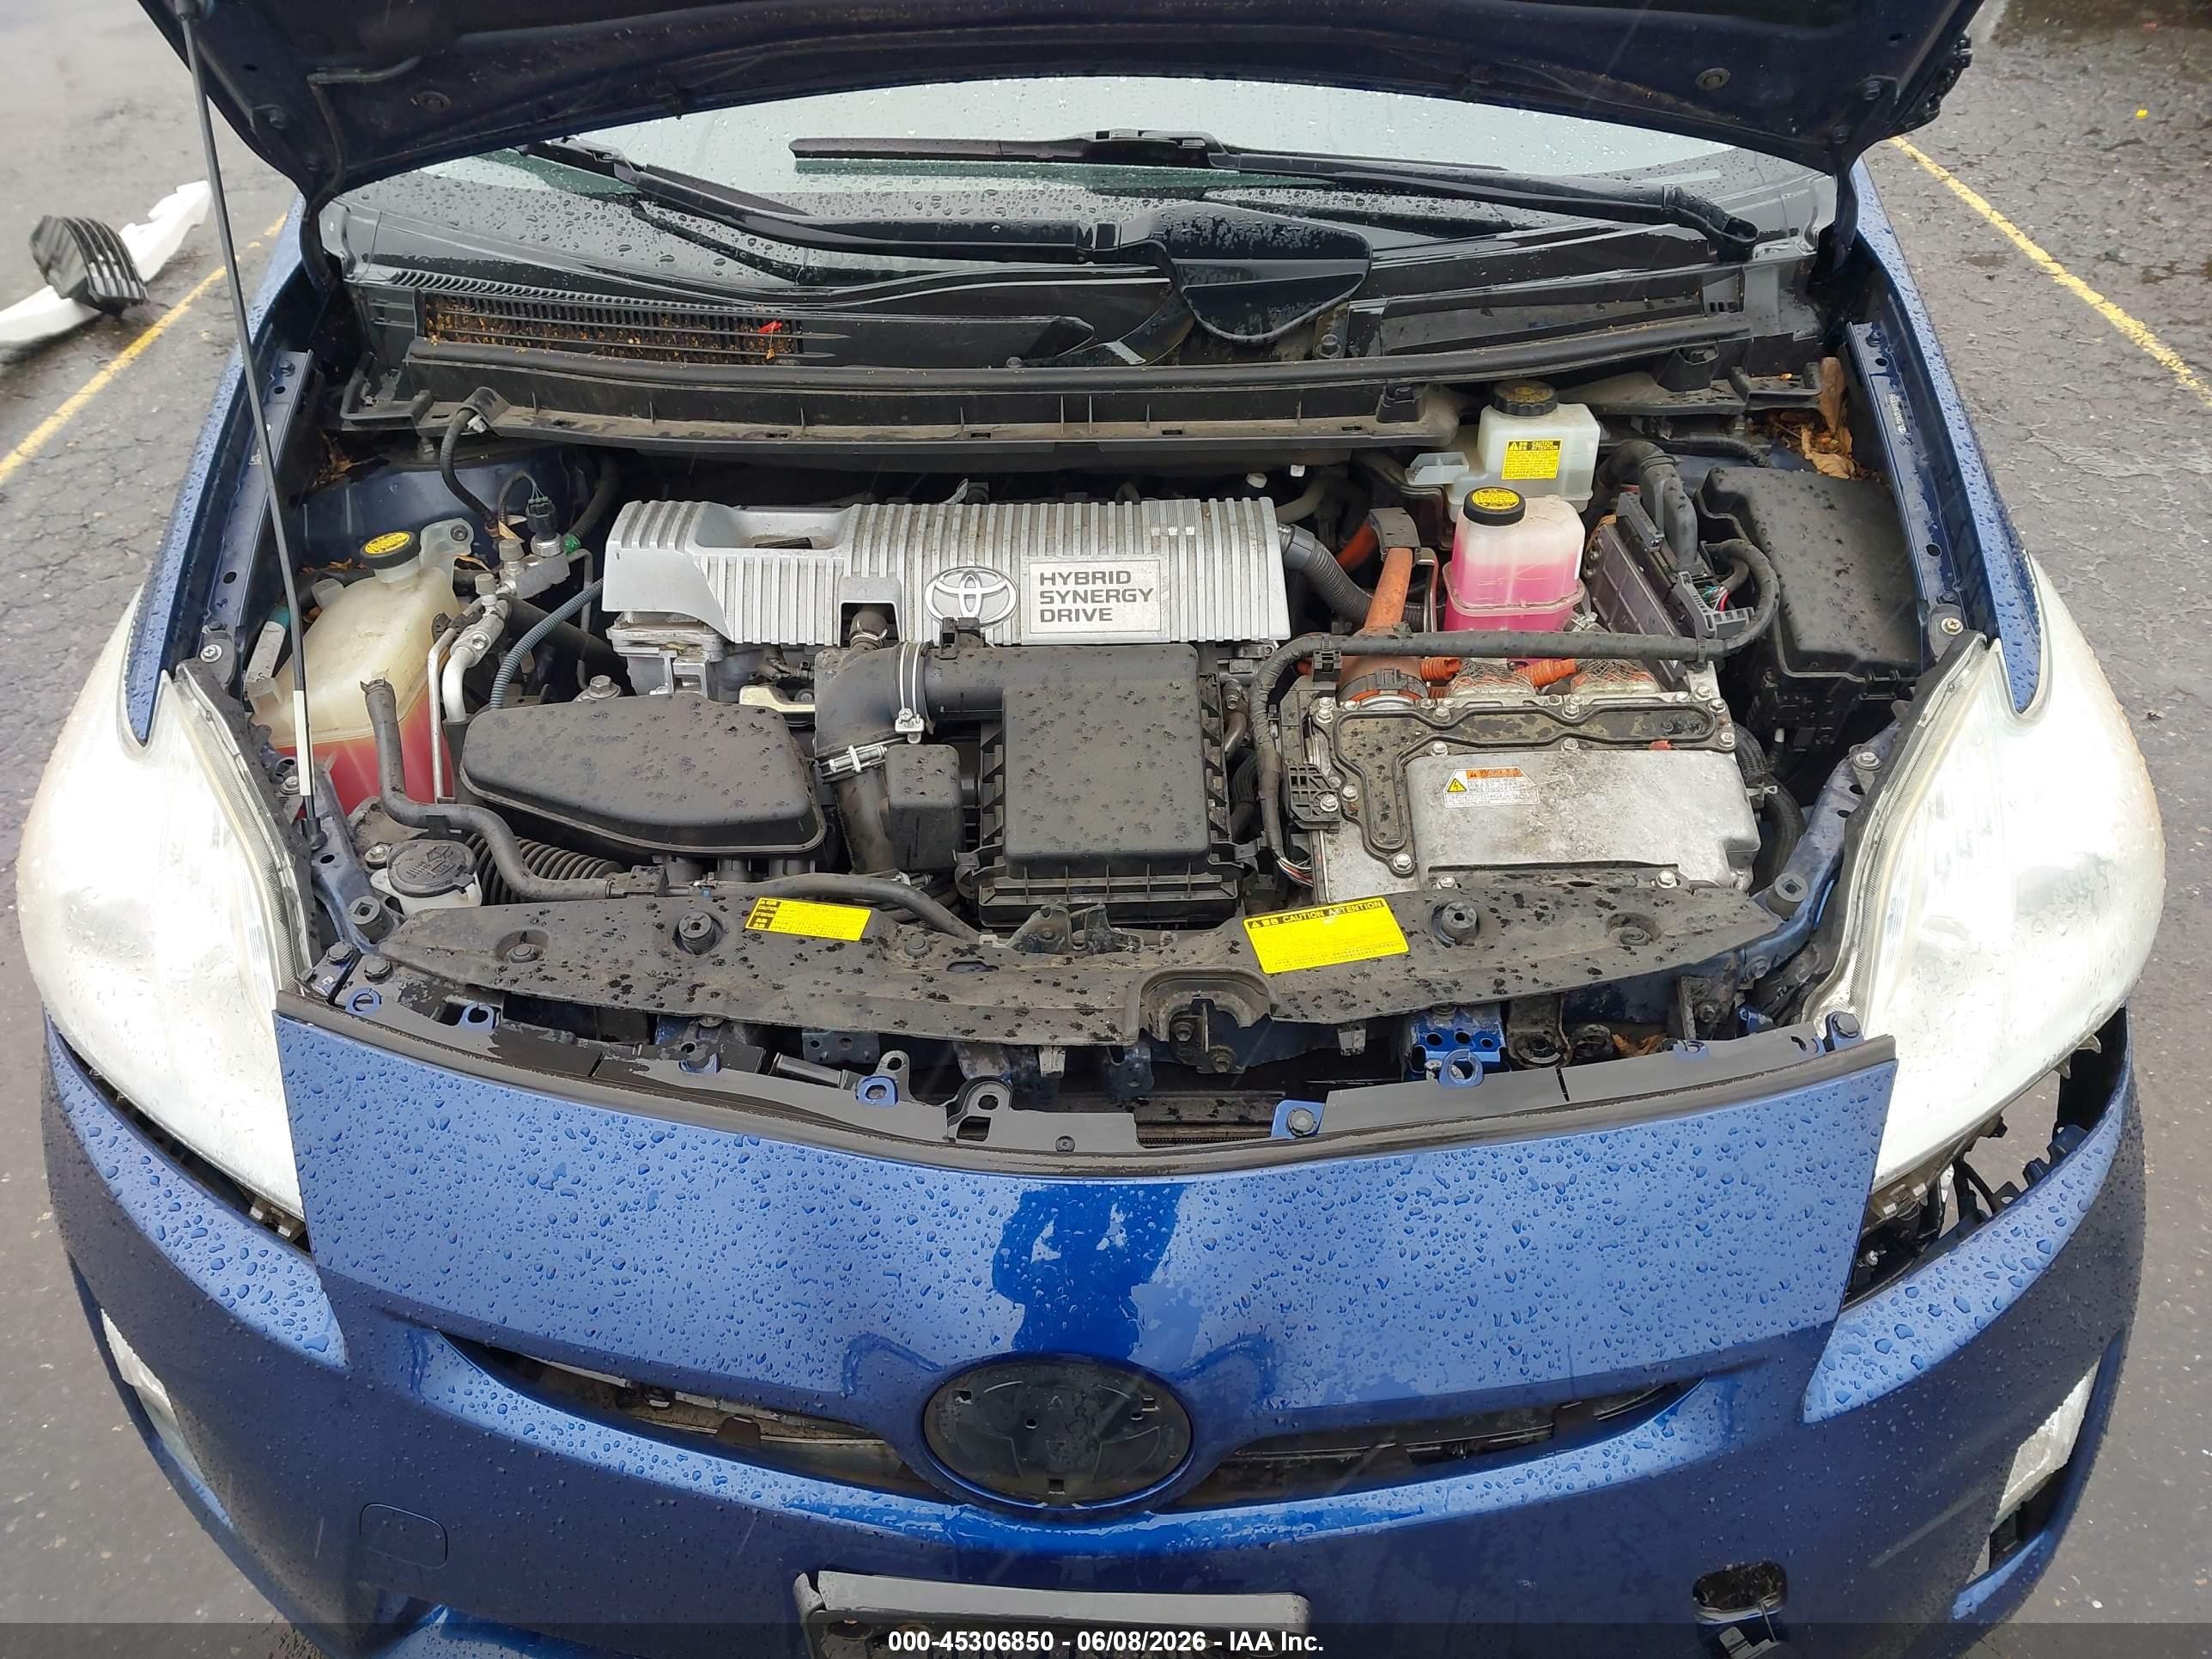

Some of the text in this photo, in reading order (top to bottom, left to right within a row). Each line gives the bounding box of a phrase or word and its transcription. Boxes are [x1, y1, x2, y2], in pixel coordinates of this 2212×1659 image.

[1039, 570, 1133, 586] HYBRID
[1039, 587, 1154, 605] SYNERGY
[1039, 607, 1114, 623] DRIVE
[1282, 910, 1325, 924] CAUTION
[1328, 901, 1383, 916] ATTENTION
